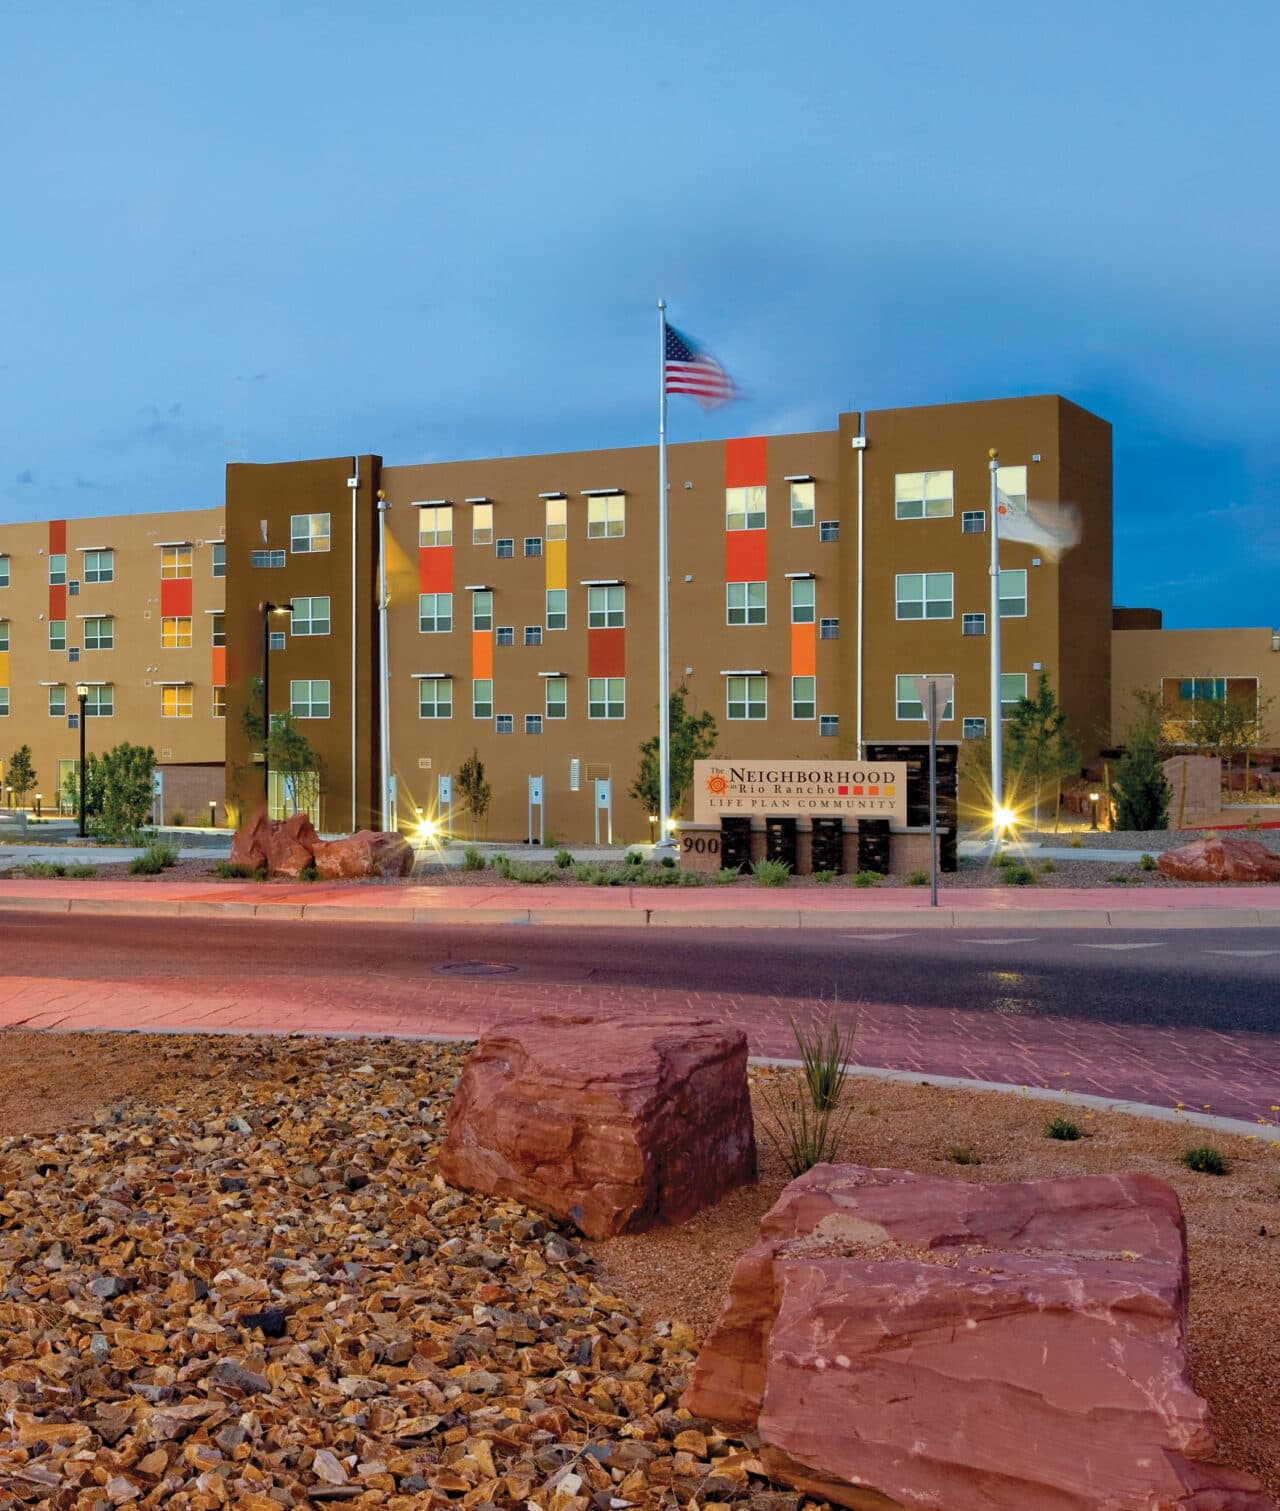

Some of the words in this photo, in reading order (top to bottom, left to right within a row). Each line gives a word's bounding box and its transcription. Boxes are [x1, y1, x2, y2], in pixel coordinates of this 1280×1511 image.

[729, 767, 896, 784] NEIGHBORHOOD
[739, 785, 766, 794] Rio
[774, 785, 835, 795] Rancho
[710, 799, 744, 807] LIFE
[751, 799, 791, 808] PLAN
[798, 799, 897, 809] COMMUNITY
[682, 837, 720, 854] 900
